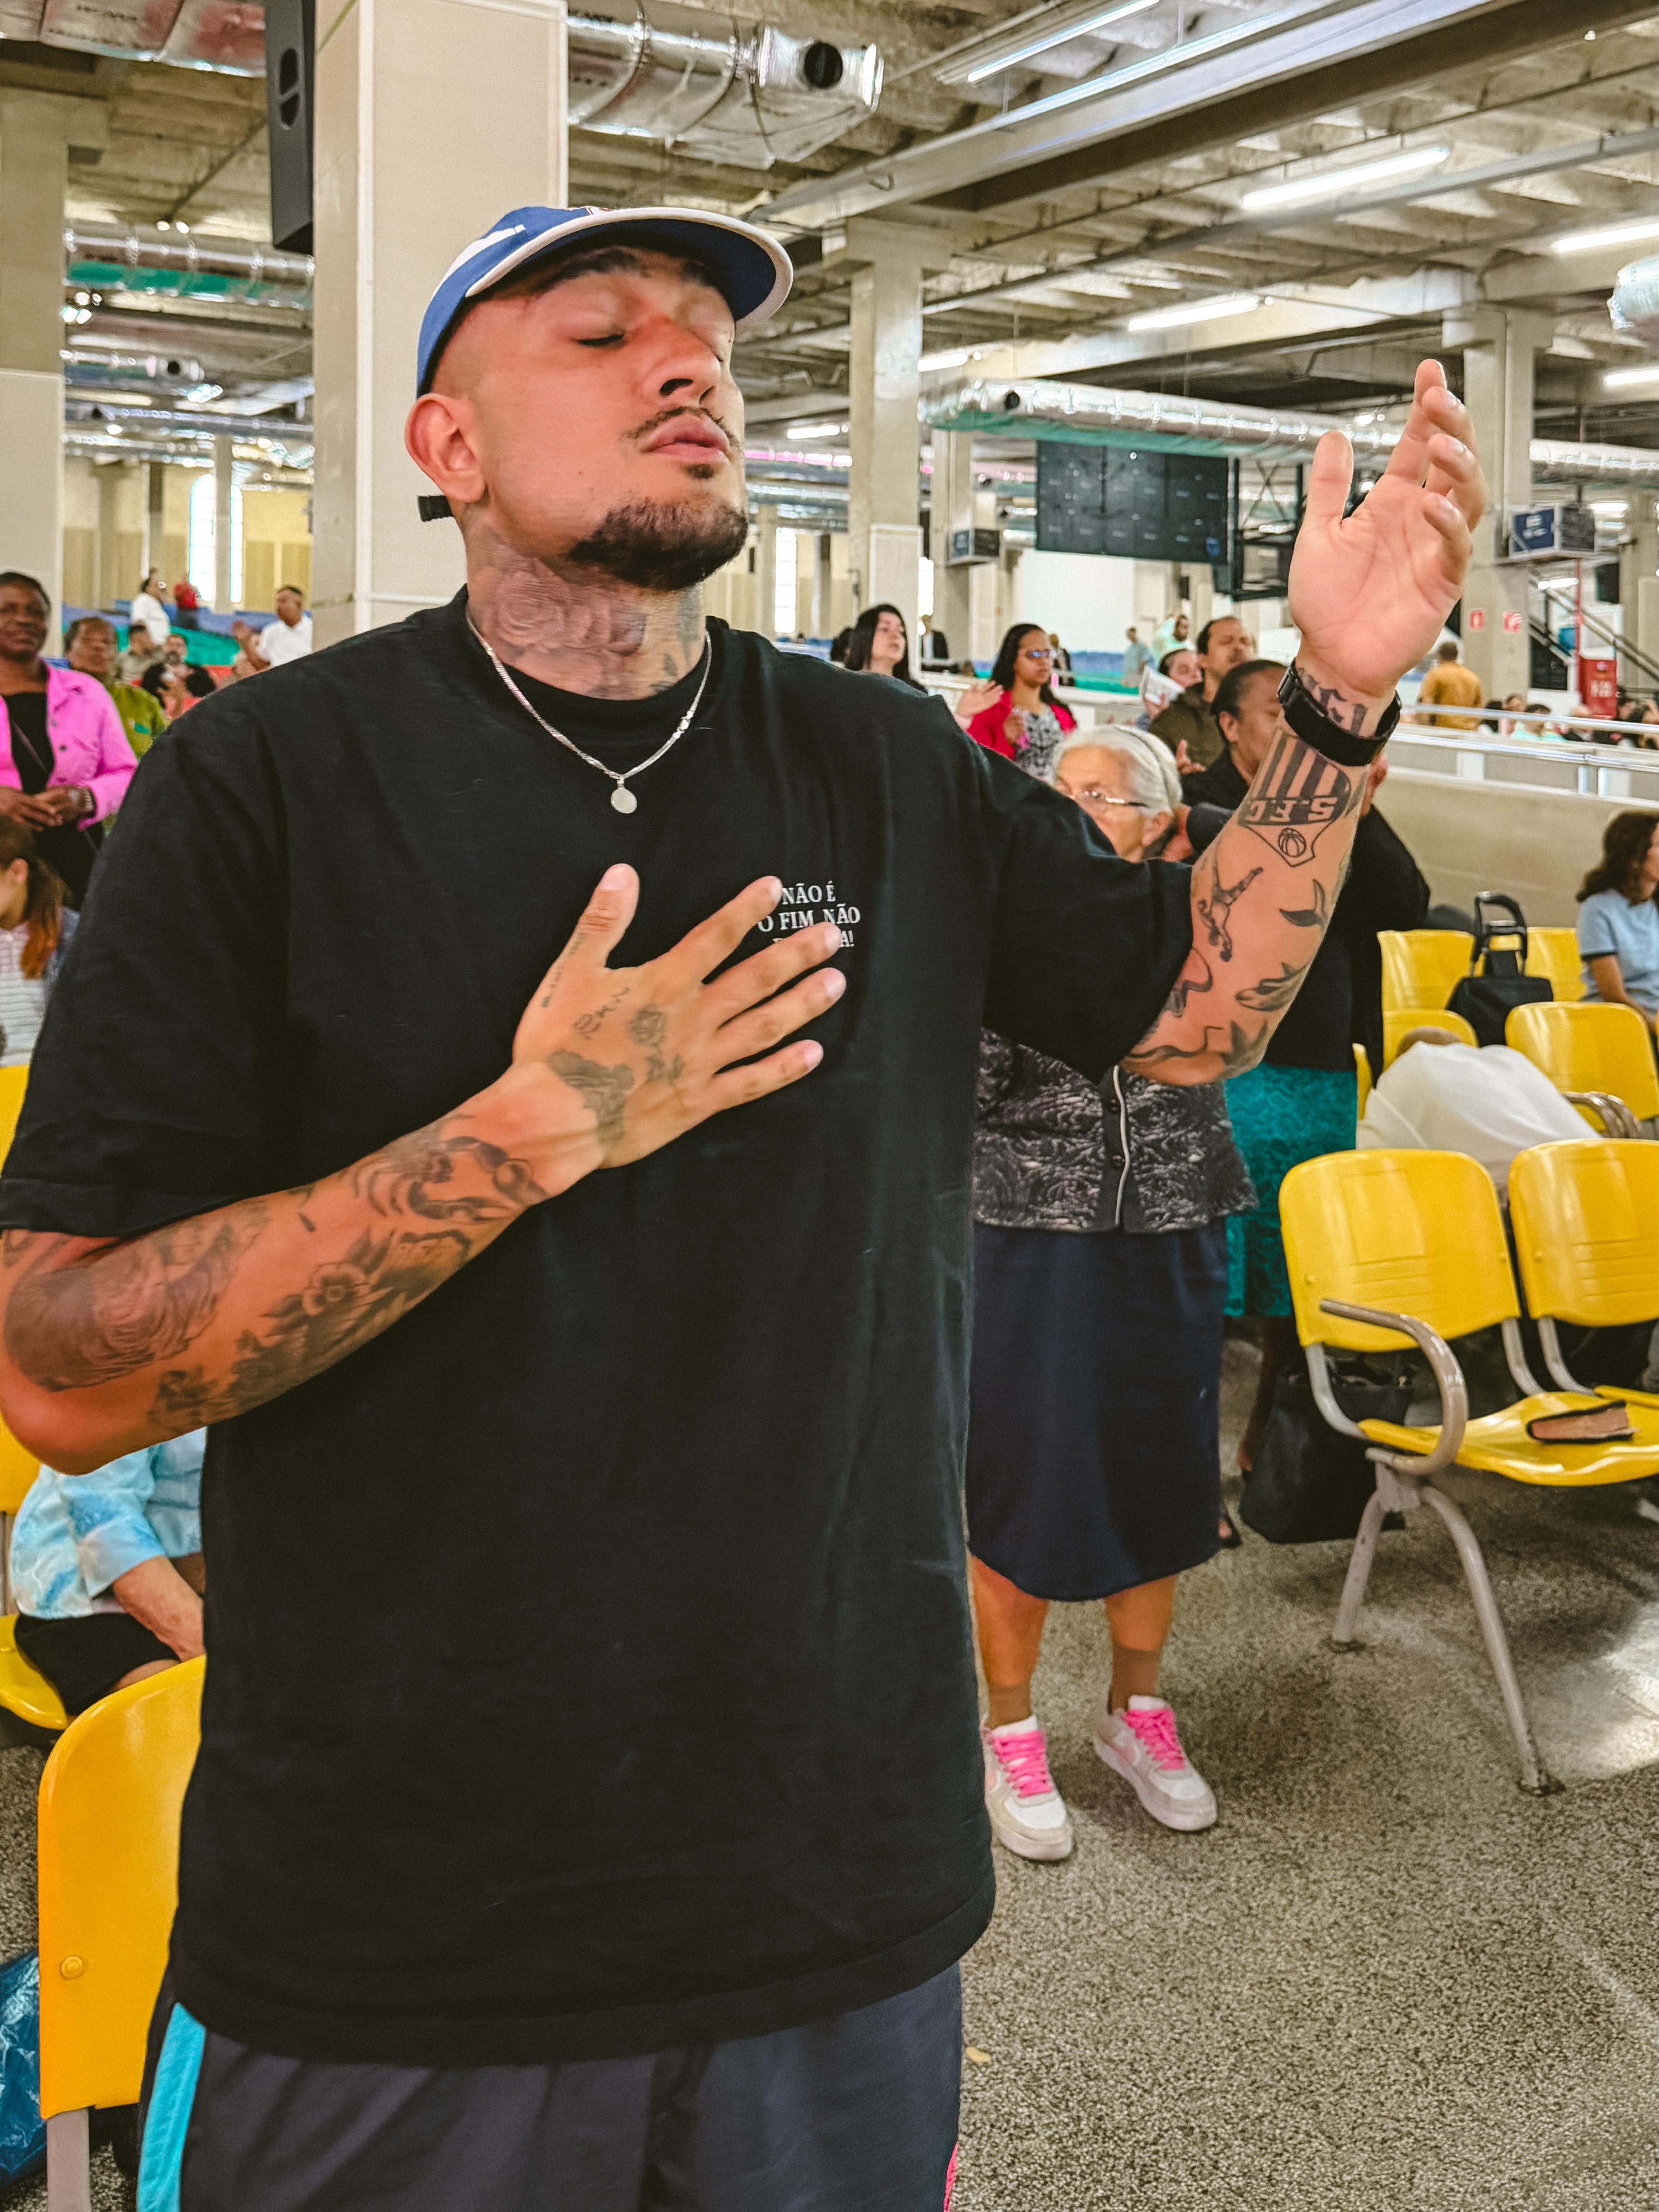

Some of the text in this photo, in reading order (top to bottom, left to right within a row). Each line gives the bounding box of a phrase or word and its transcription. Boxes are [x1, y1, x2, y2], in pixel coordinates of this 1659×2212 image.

[782, 880, 836, 905] NÃO É
[758, 903, 861, 932] O FIM NÃO
